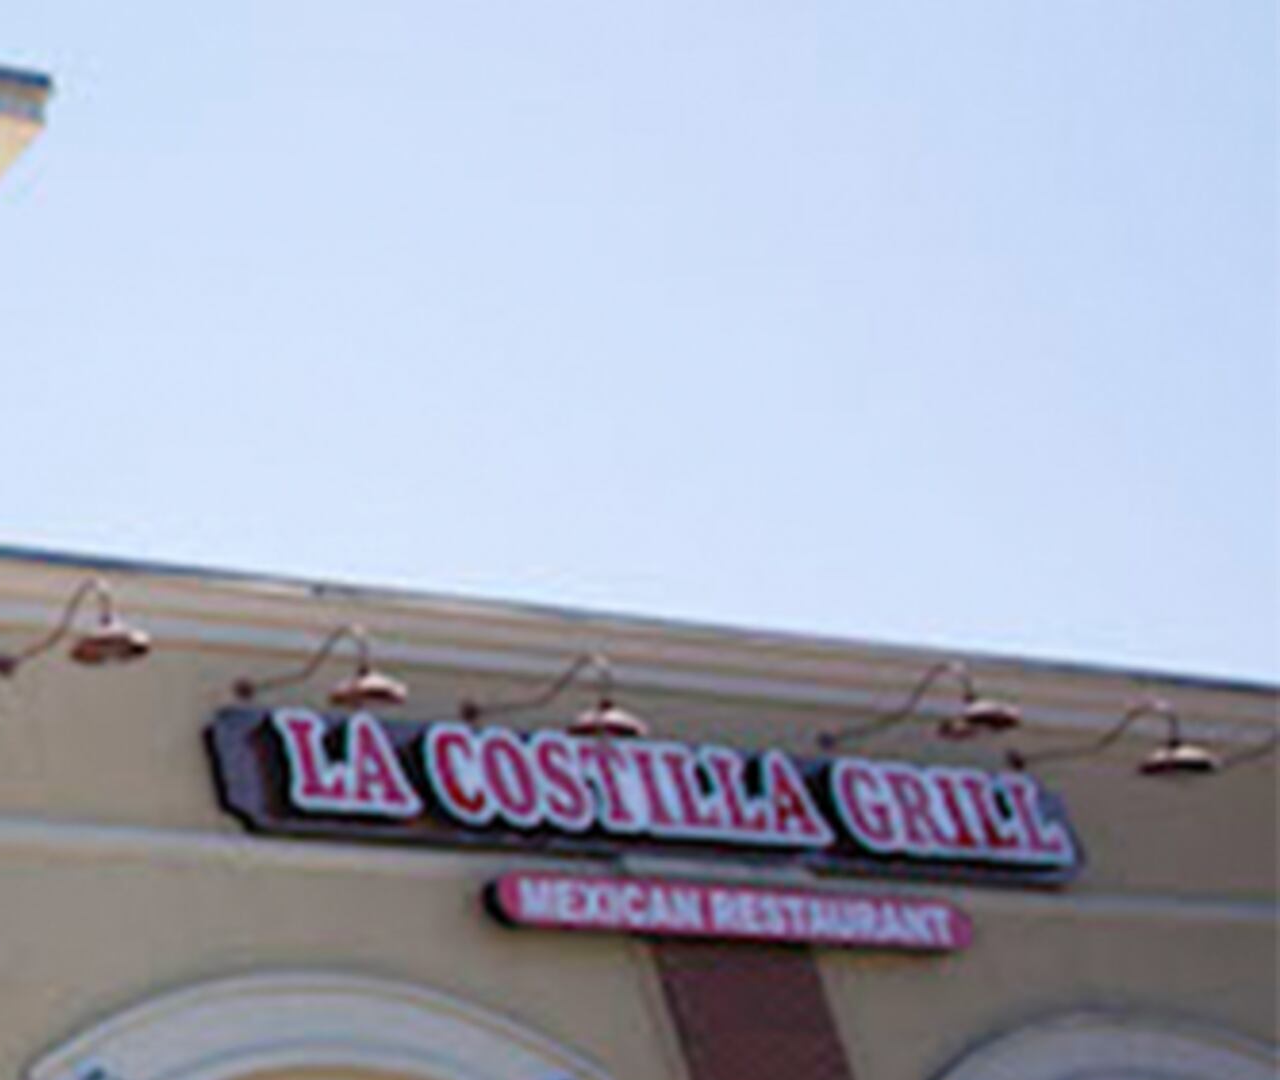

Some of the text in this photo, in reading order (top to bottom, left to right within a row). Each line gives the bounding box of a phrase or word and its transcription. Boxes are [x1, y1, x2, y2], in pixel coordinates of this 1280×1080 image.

[274, 710, 1076, 867] LA COSTILLA GRILL
[517, 877, 956, 947] MEXICAN RESTAURANT
